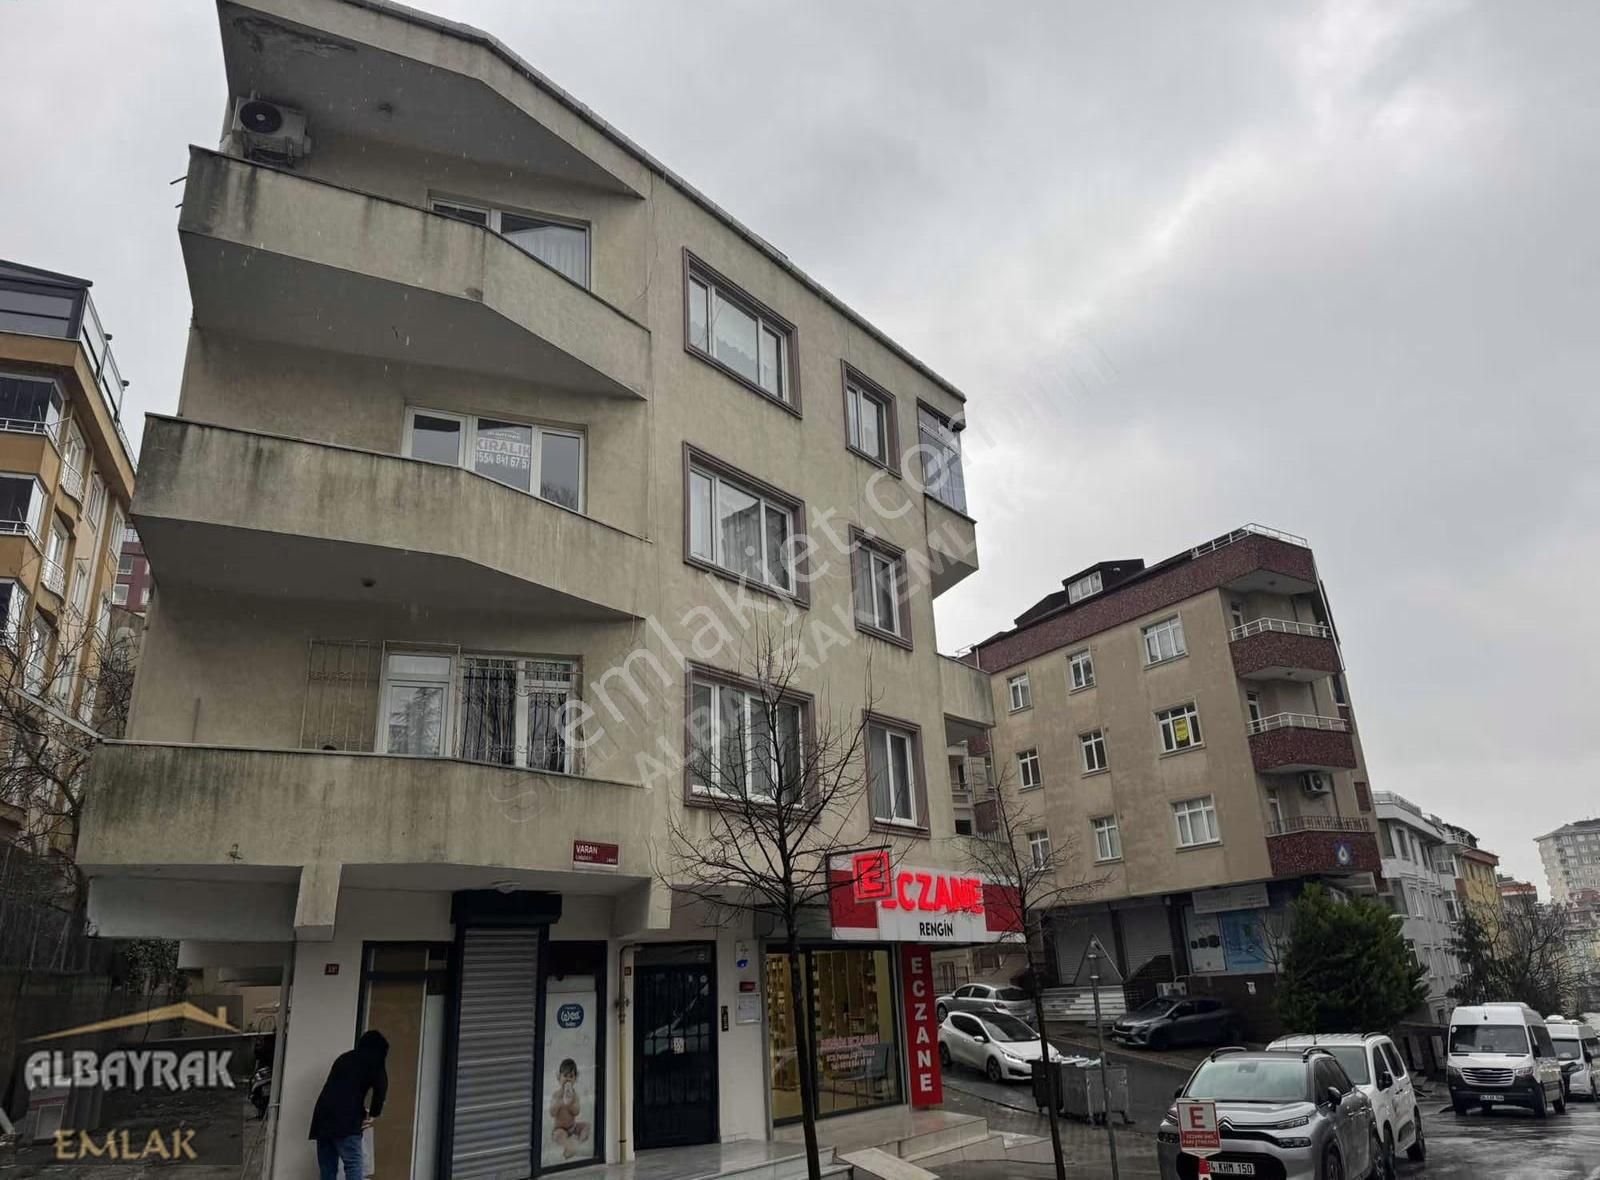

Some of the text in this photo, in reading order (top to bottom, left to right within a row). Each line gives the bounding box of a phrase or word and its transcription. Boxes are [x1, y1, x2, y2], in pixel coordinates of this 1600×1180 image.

[576, 844, 598, 854] VARAN
[919, 920, 954, 937] RENGİN
[911, 956, 933, 1092] ECZANE
[1189, 1107, 1206, 1128] E
